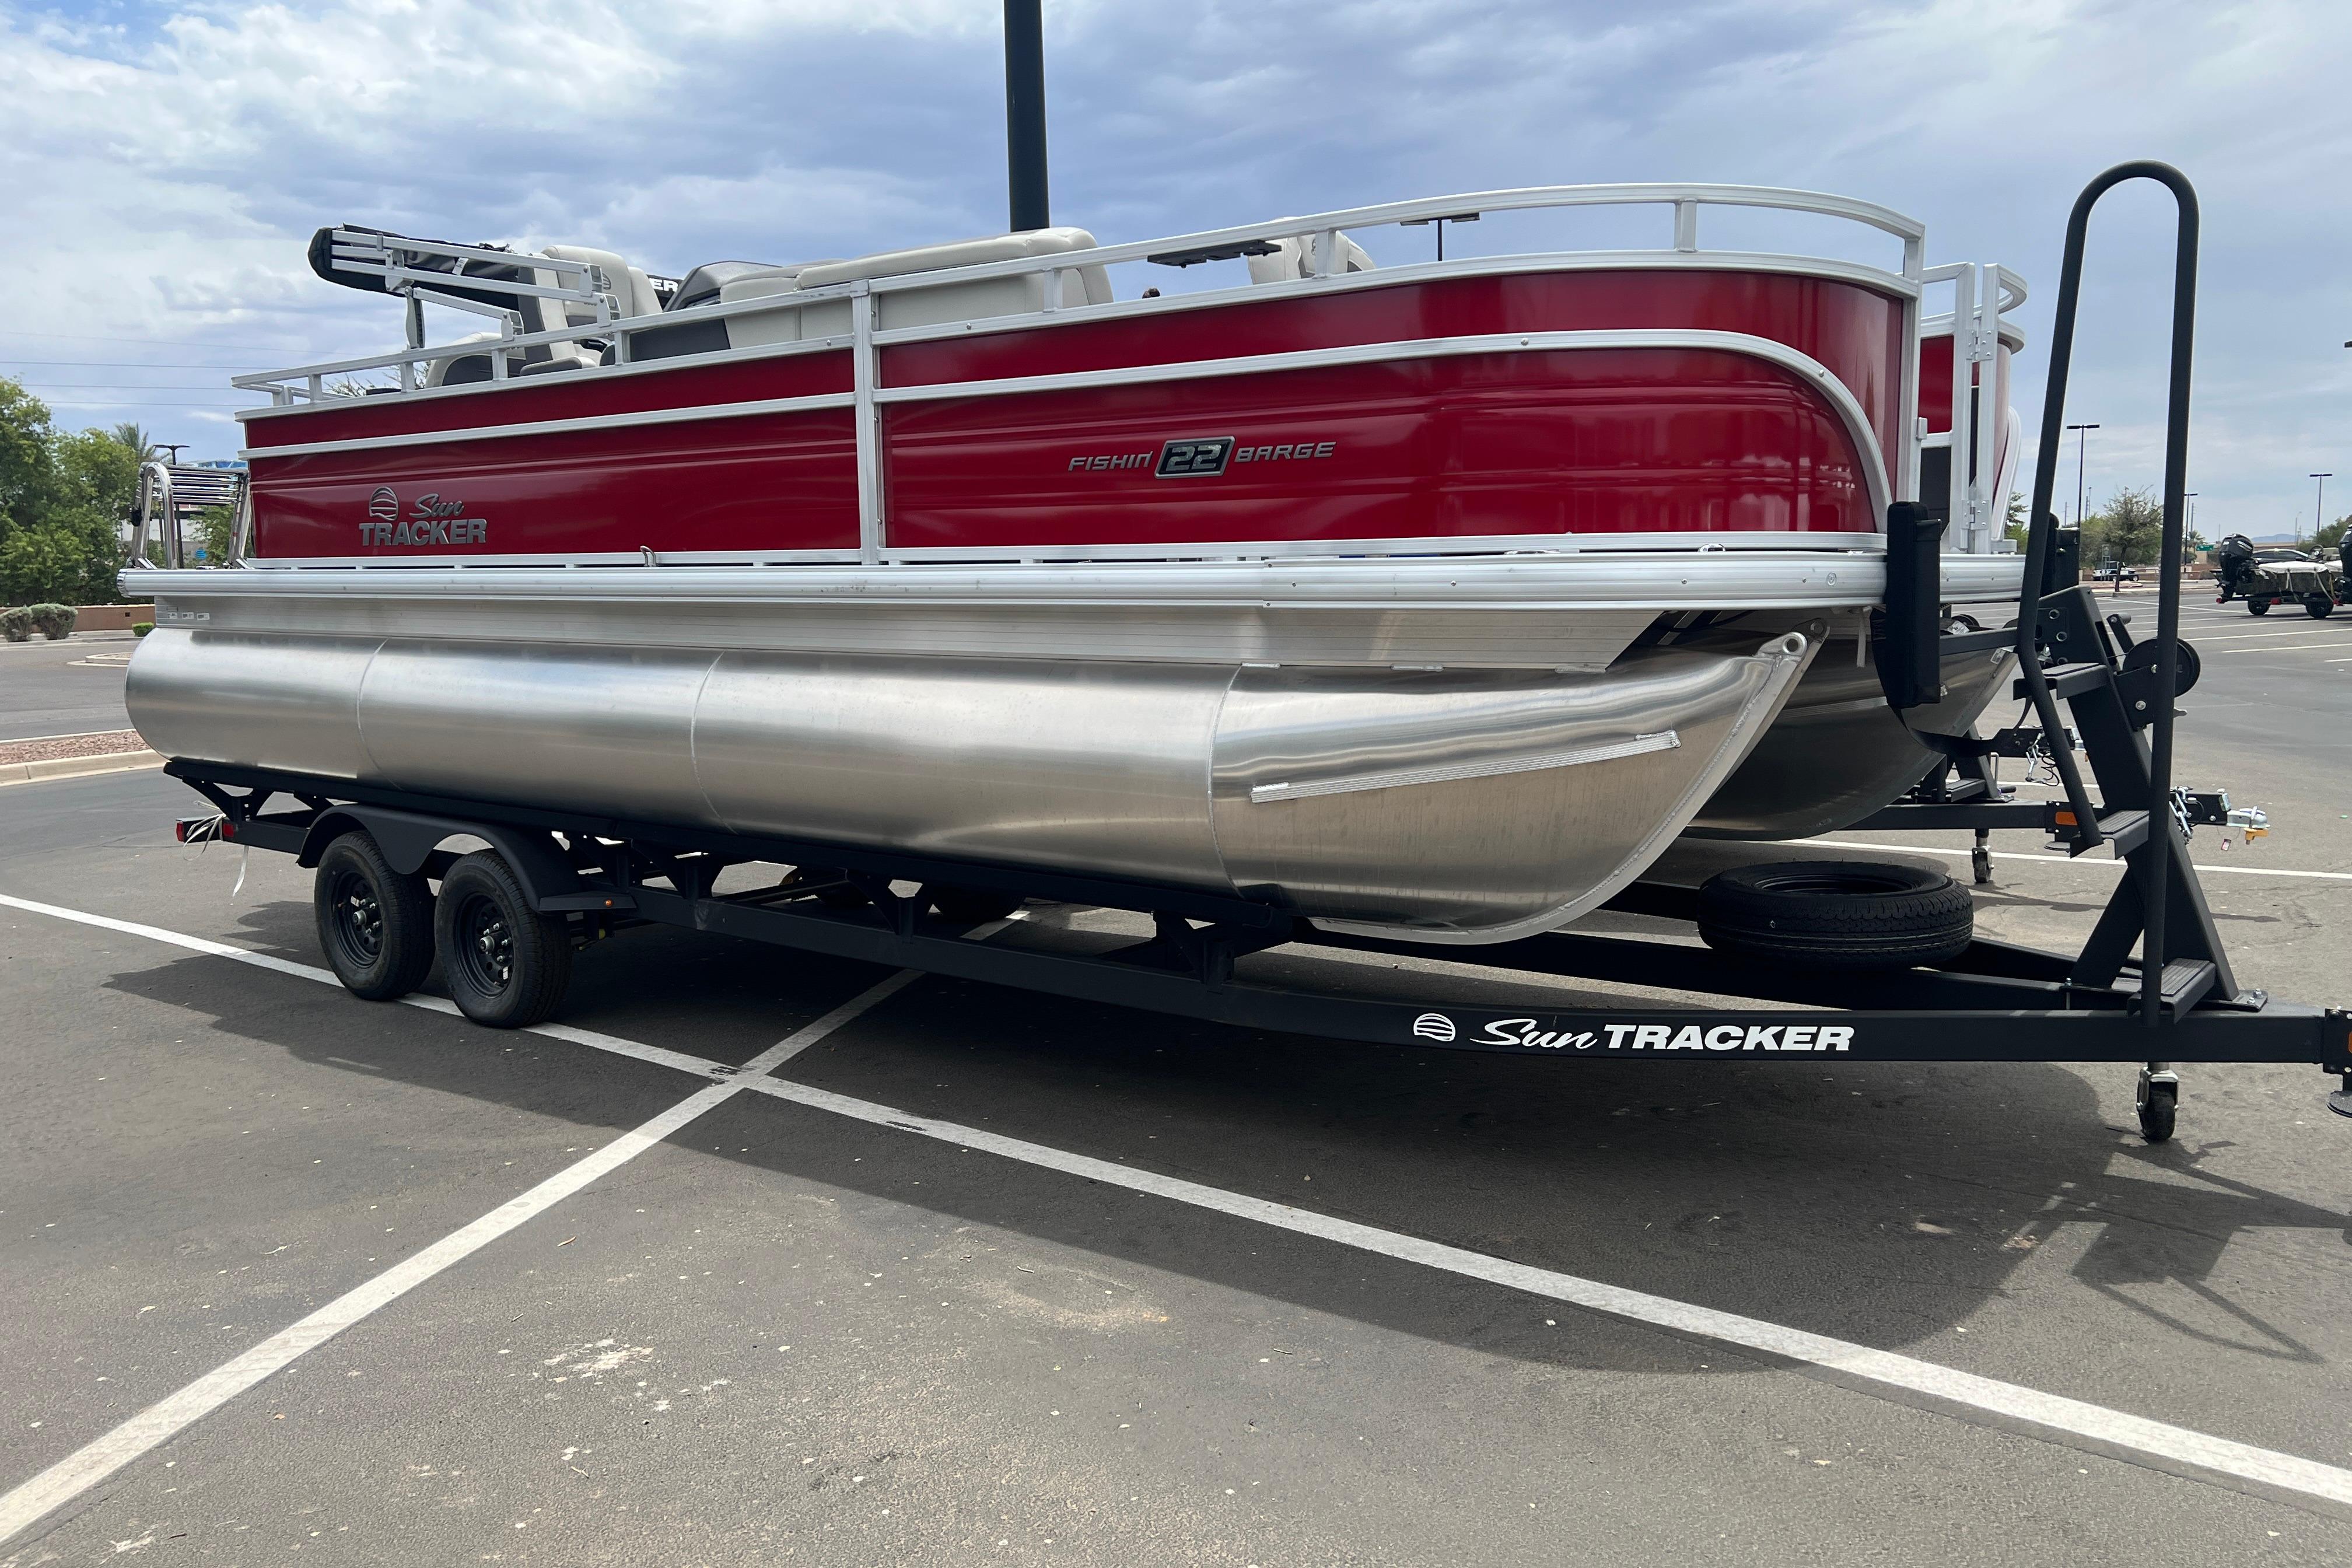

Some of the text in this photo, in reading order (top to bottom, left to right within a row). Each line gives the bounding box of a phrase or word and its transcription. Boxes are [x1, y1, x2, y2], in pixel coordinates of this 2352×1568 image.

[649, 279, 678, 292] ER
[1166, 444, 1222, 471] 22
[1234, 442, 1336, 462] BARGE
[409, 494, 464, 518] Sun
[359, 519, 487, 546] TRACKER
[1470, 1019, 1855, 1051] Sun TRACKER
